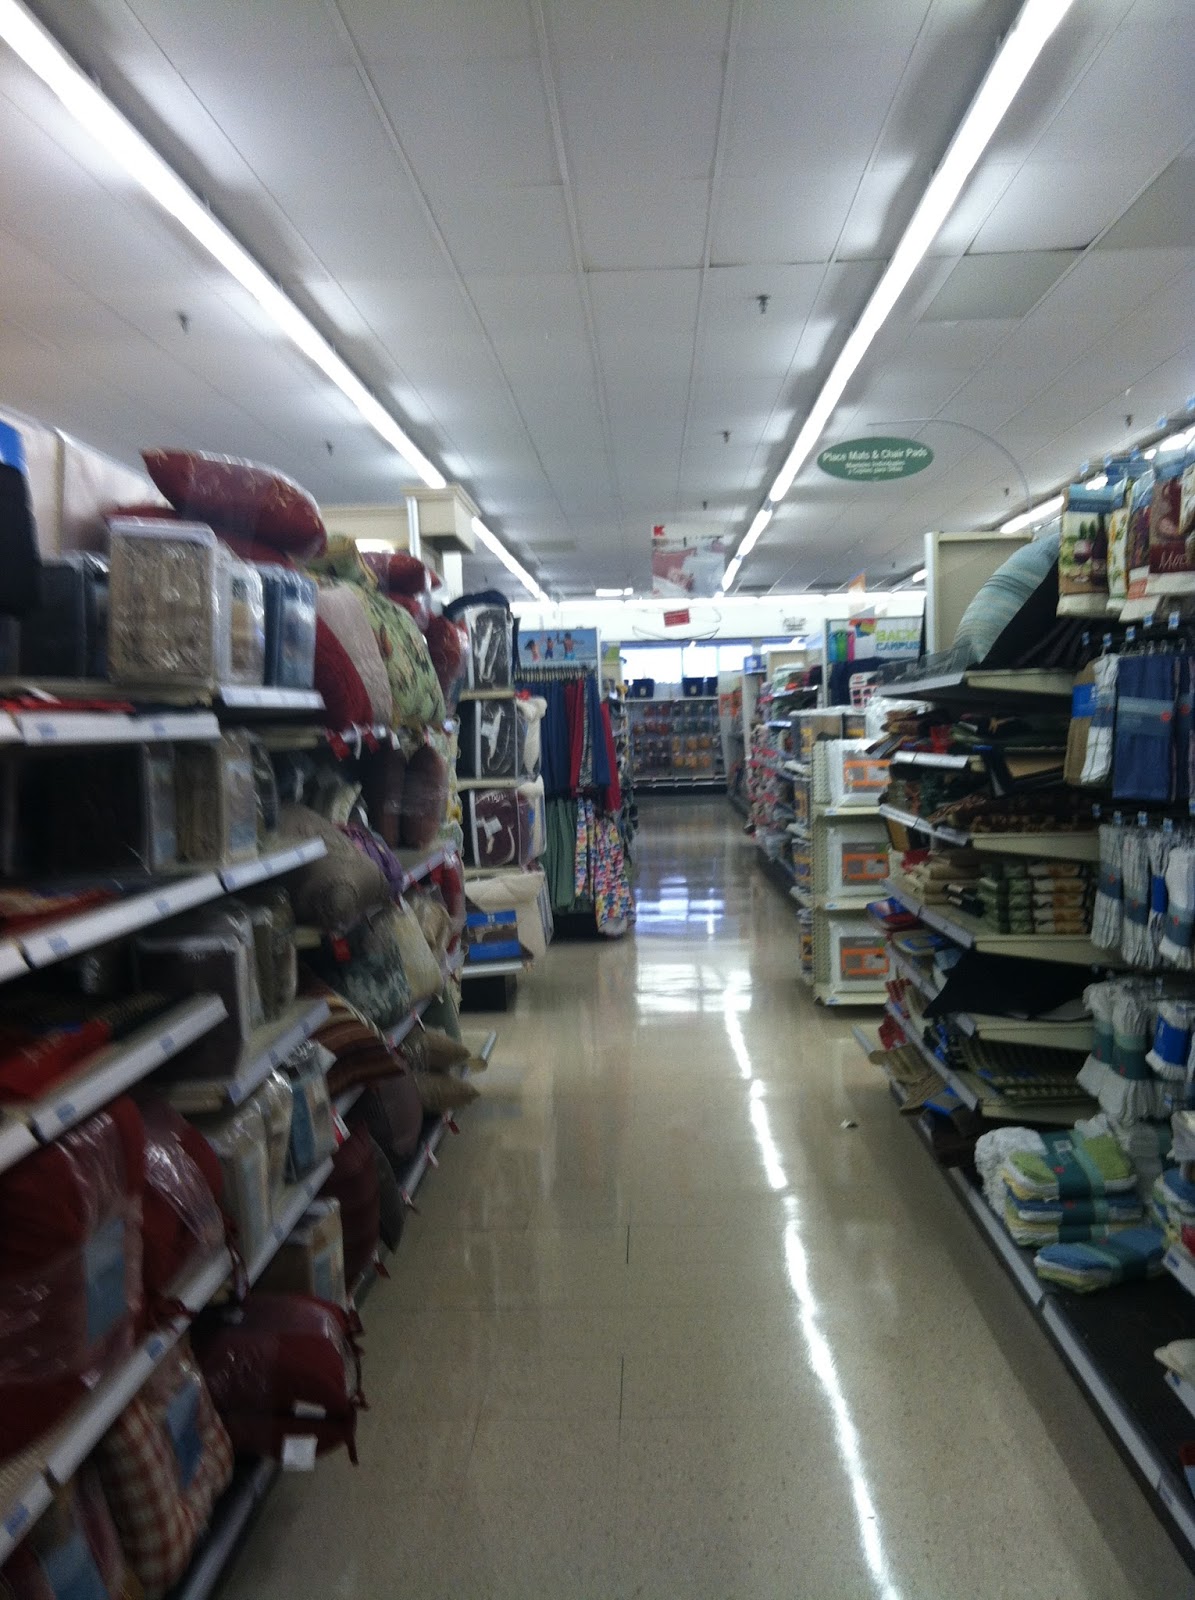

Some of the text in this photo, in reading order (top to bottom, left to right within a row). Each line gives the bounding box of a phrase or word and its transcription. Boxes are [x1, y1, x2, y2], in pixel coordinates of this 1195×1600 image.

[822, 447, 928, 463] Place Mats & Chair Pads
[876, 629, 919, 642] BACK
[876, 640, 920, 651] CAMPUS
